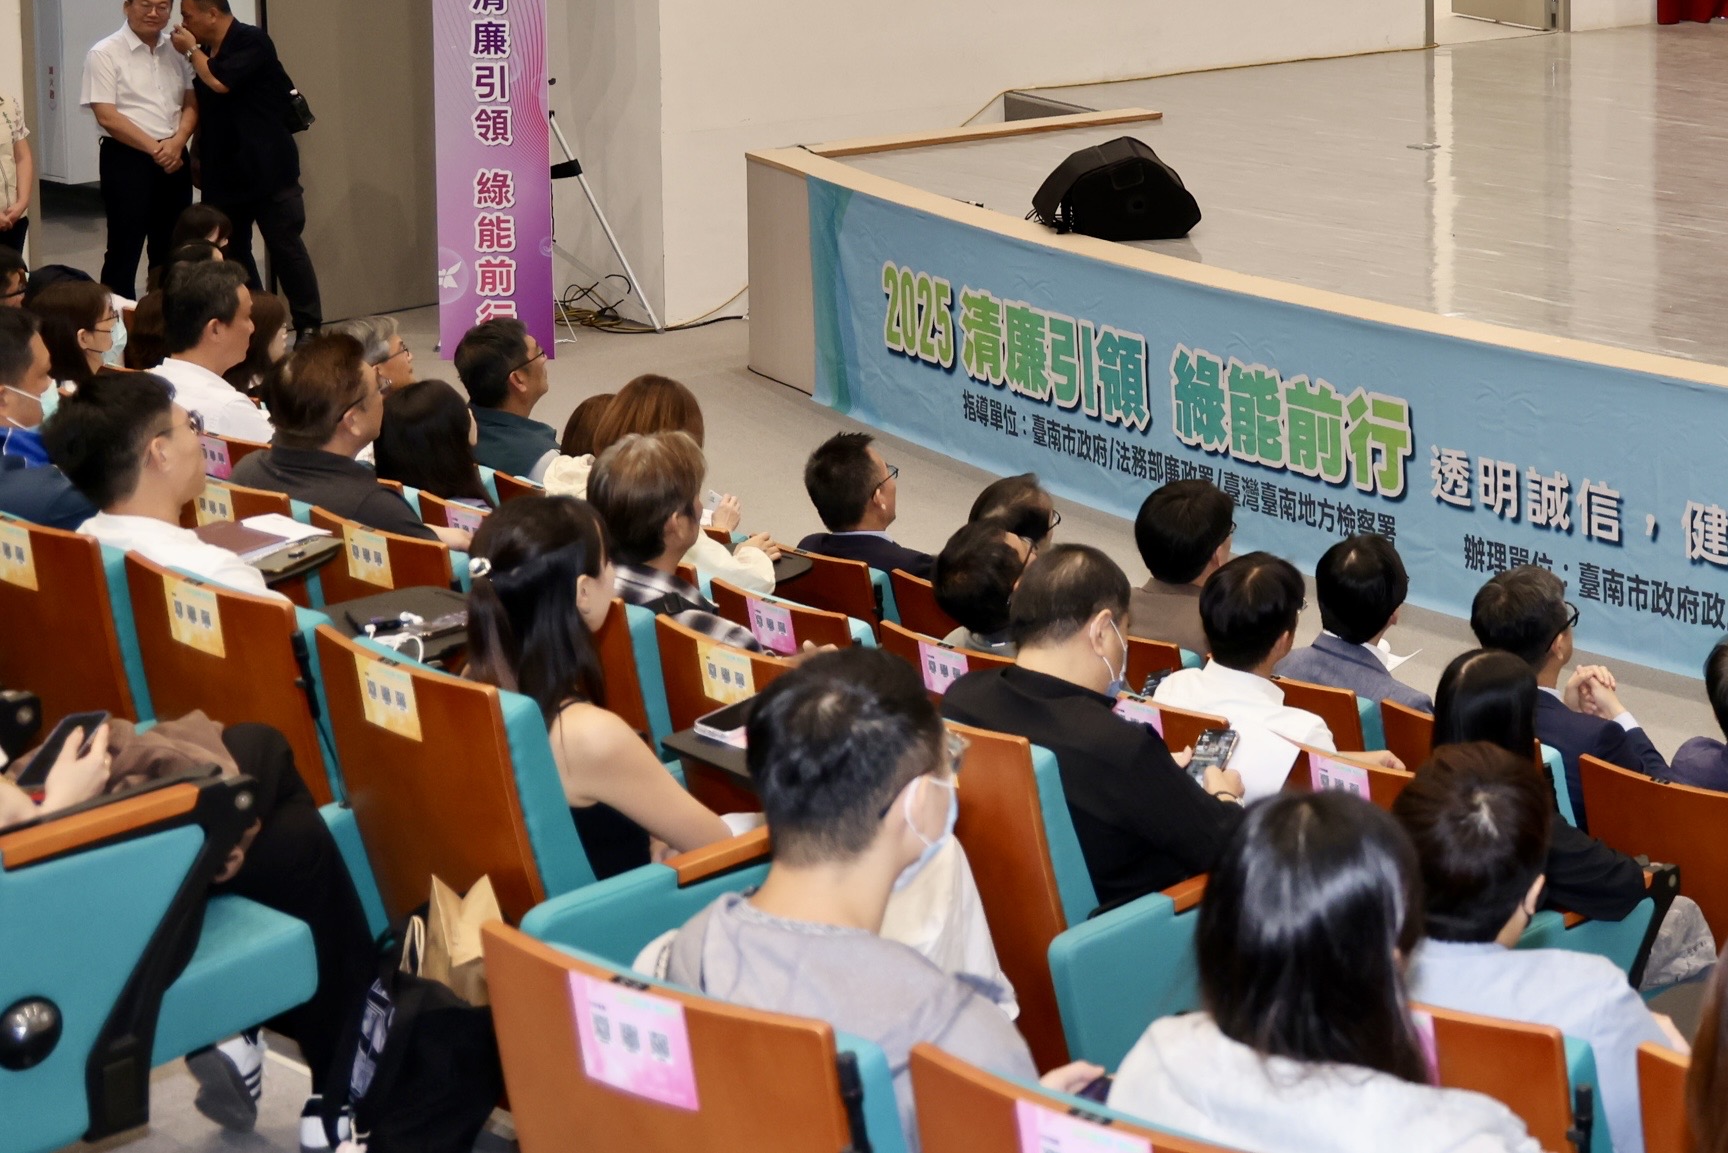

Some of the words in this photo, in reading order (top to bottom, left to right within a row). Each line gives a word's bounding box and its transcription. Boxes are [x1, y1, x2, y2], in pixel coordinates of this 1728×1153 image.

[881, 260, 954, 368] 2025
[959, 284, 1152, 431] 清廉引領
[1170, 344, 1412, 498] 綠能前行
